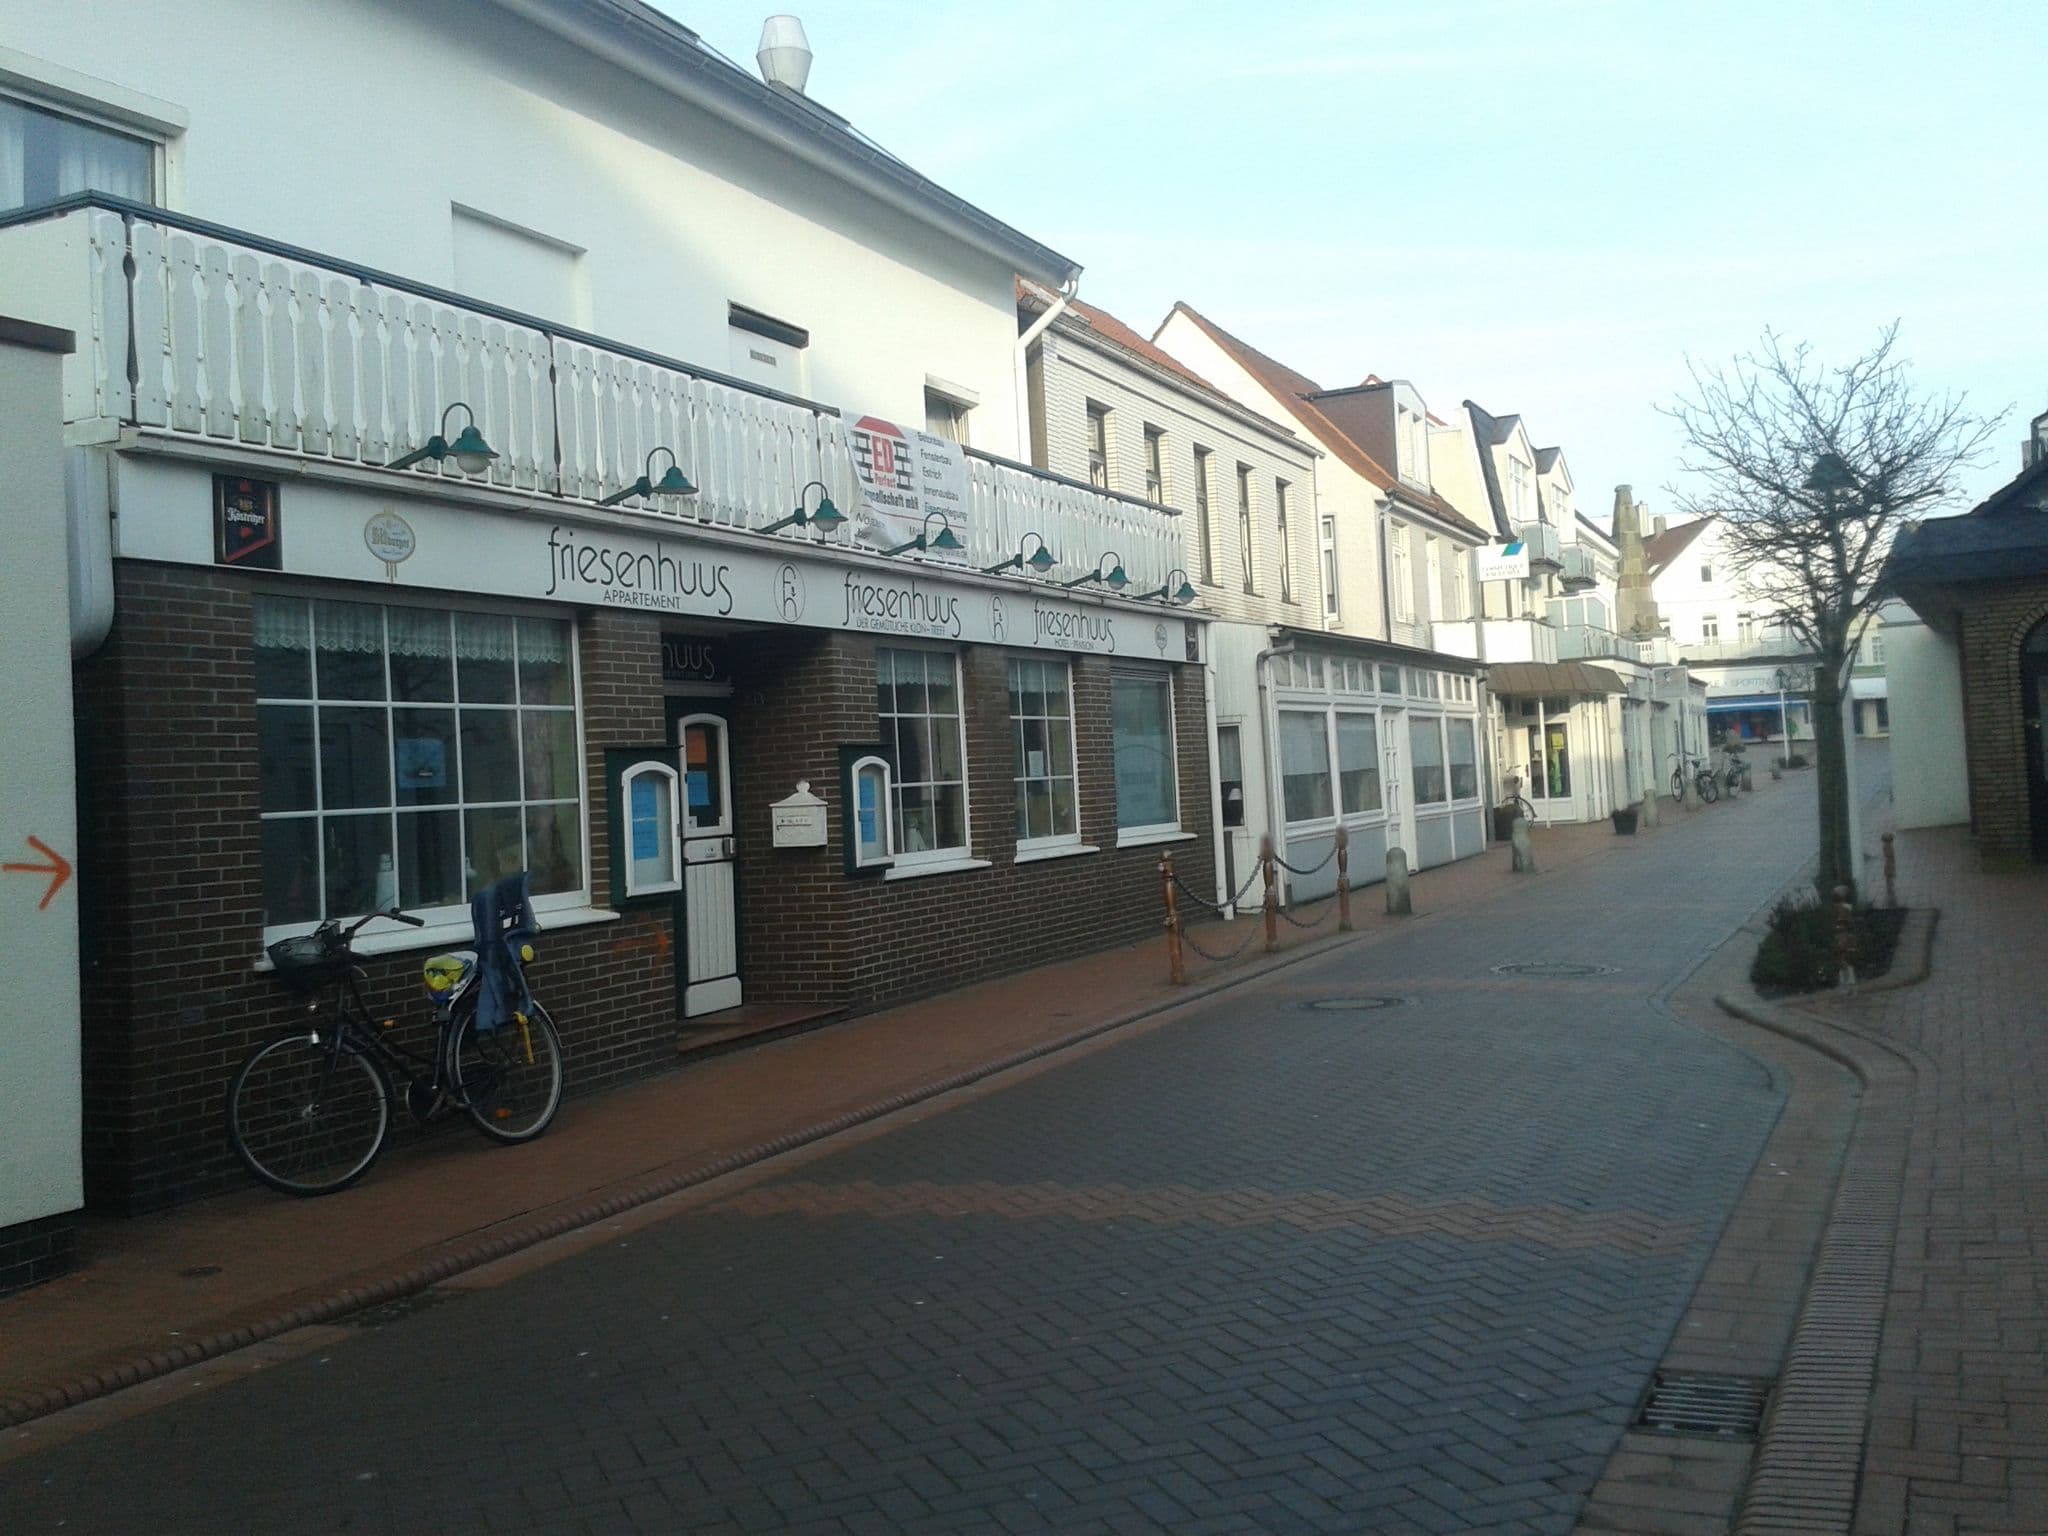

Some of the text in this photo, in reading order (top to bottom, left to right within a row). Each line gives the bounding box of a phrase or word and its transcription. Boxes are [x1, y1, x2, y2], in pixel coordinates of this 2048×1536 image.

[546, 525, 733, 615] friesenhuus
[603, 589, 682, 609] APPARTEMENT
[842, 571, 961, 638] friesenhuus
[1033, 599, 1115, 653] friesenhuus
